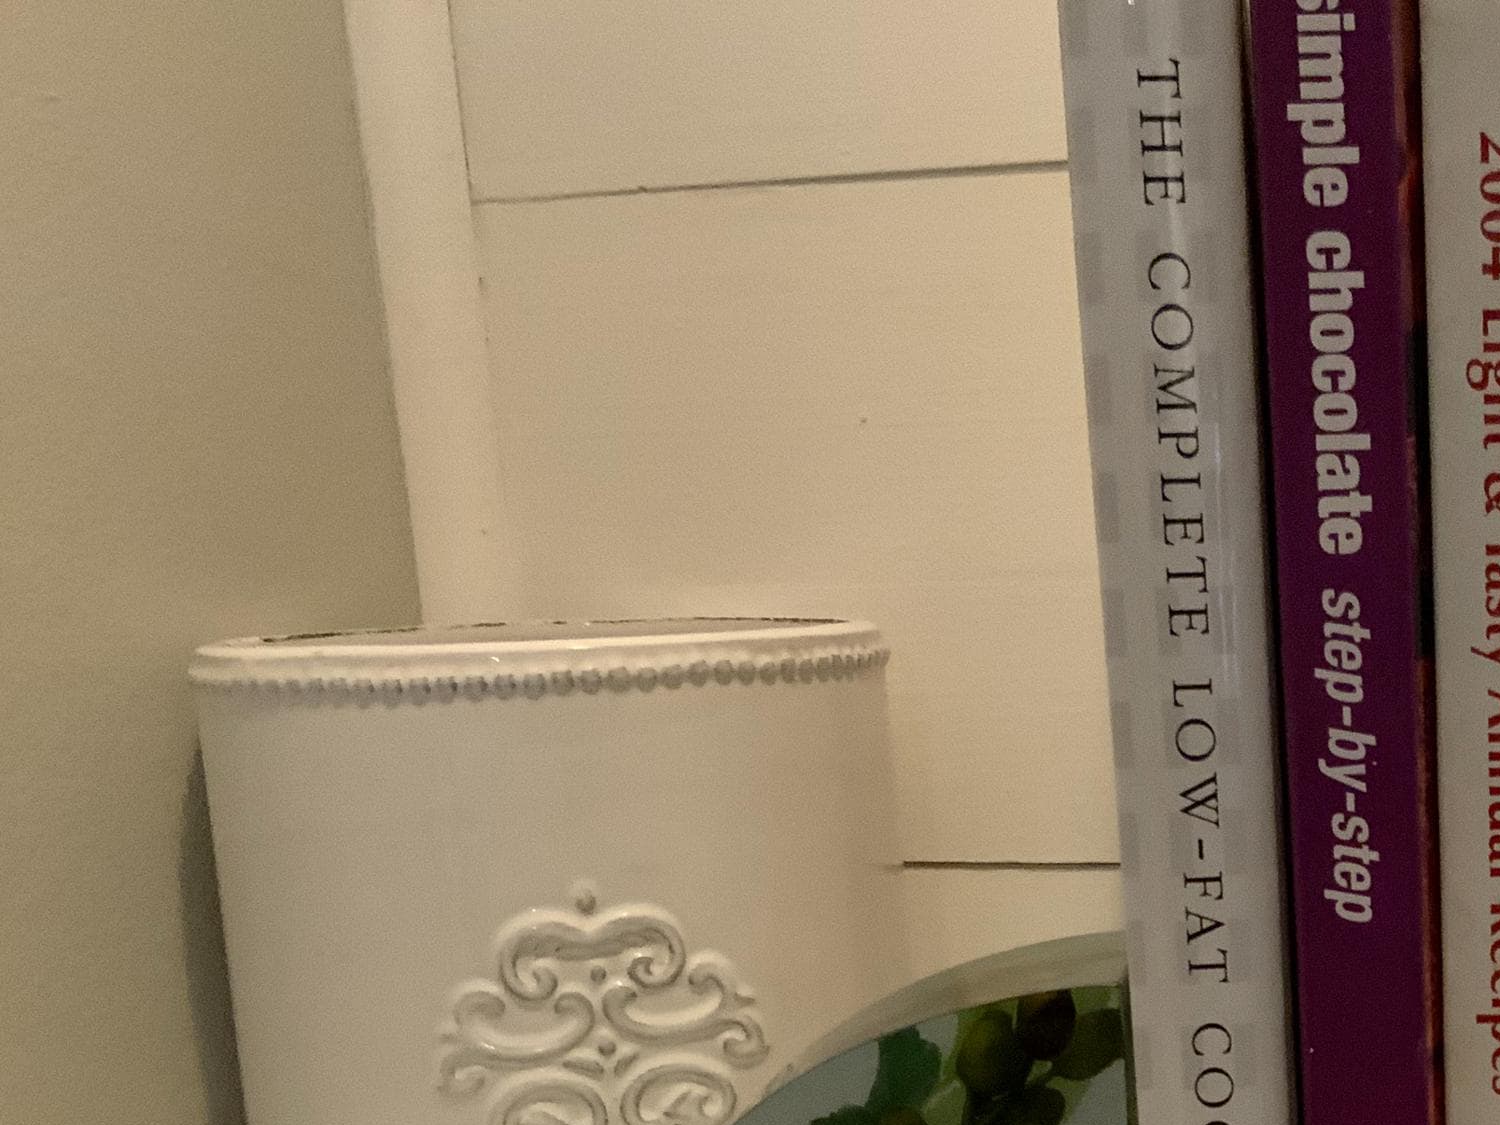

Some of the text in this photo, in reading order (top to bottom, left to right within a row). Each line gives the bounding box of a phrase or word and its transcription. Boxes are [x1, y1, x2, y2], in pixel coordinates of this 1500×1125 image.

[1136, 58, 1186, 206] THE
[1147, 252, 1210, 637] COMPLETE
[1305, 230, 1373, 556] chocolate
[1171, 677, 1230, 983] LOW-FAT
[1314, 588, 1381, 924] step-by-step
